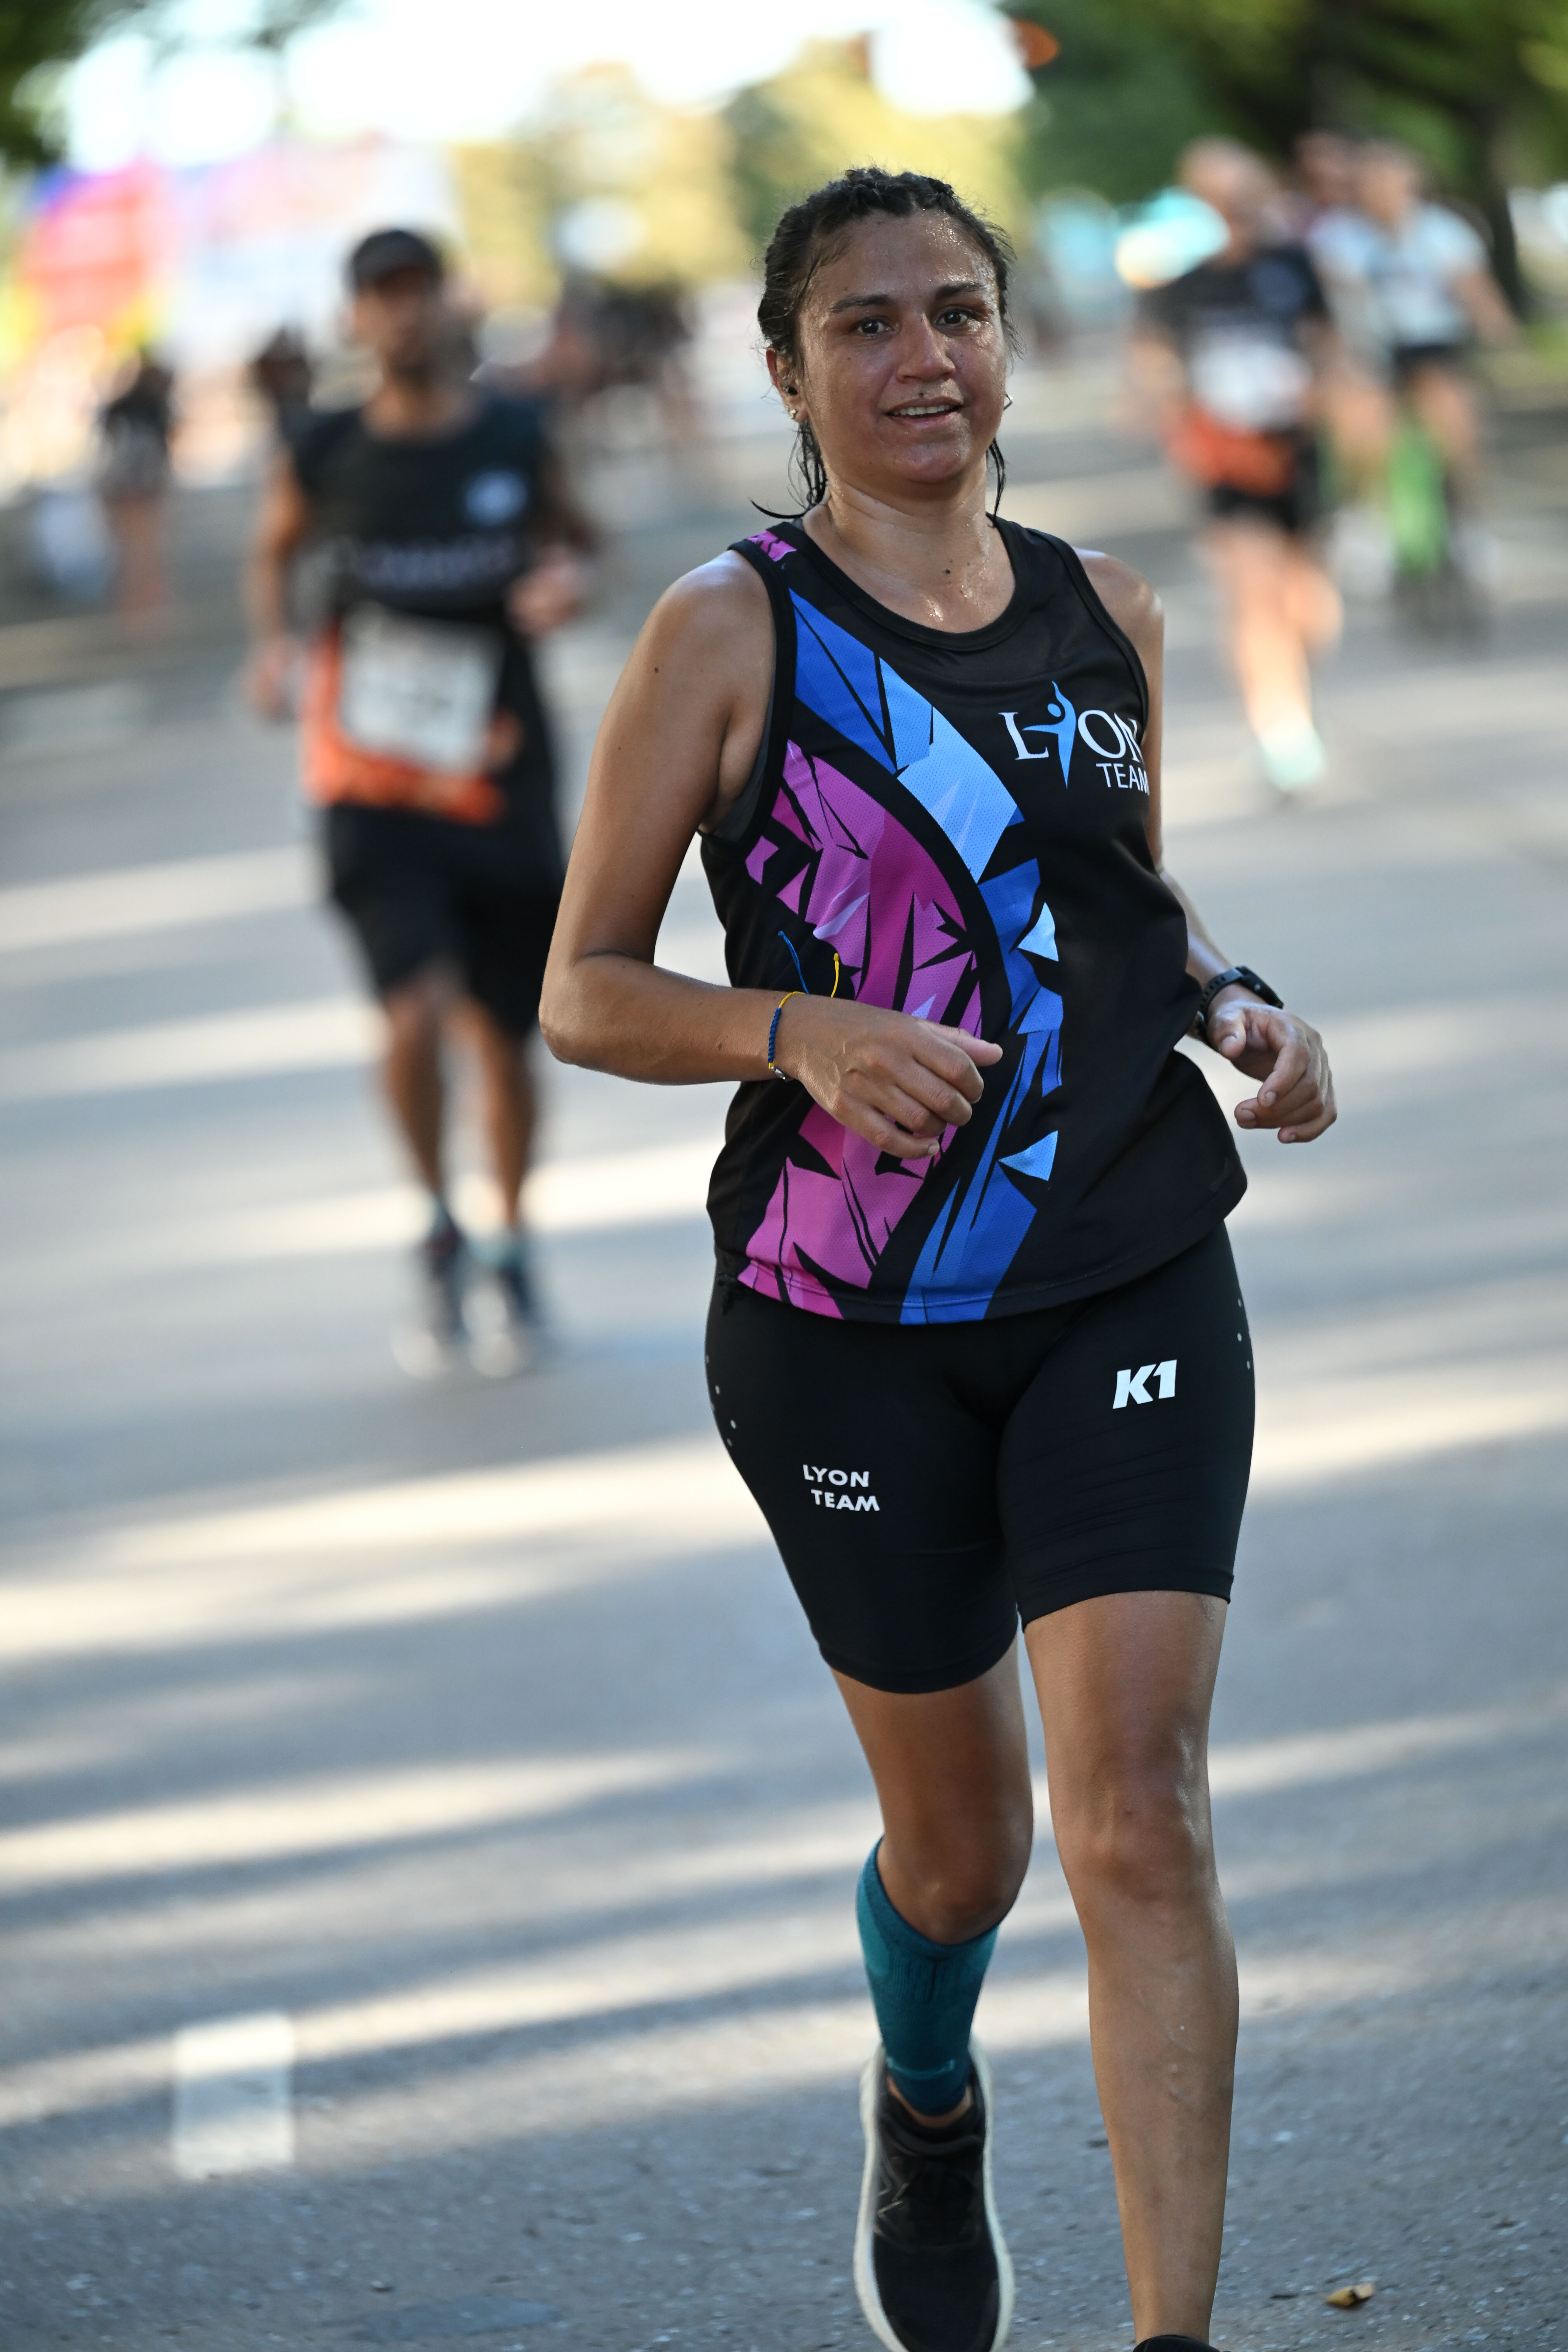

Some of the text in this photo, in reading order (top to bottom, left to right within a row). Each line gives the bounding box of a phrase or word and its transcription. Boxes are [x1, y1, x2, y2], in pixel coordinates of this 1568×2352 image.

[1096, 763, 1150, 796] TEAM
[1112, 1359, 1178, 1409] K1
[803, 1464, 870, 1487] LYON
[810, 1488, 880, 1512] TEAM
